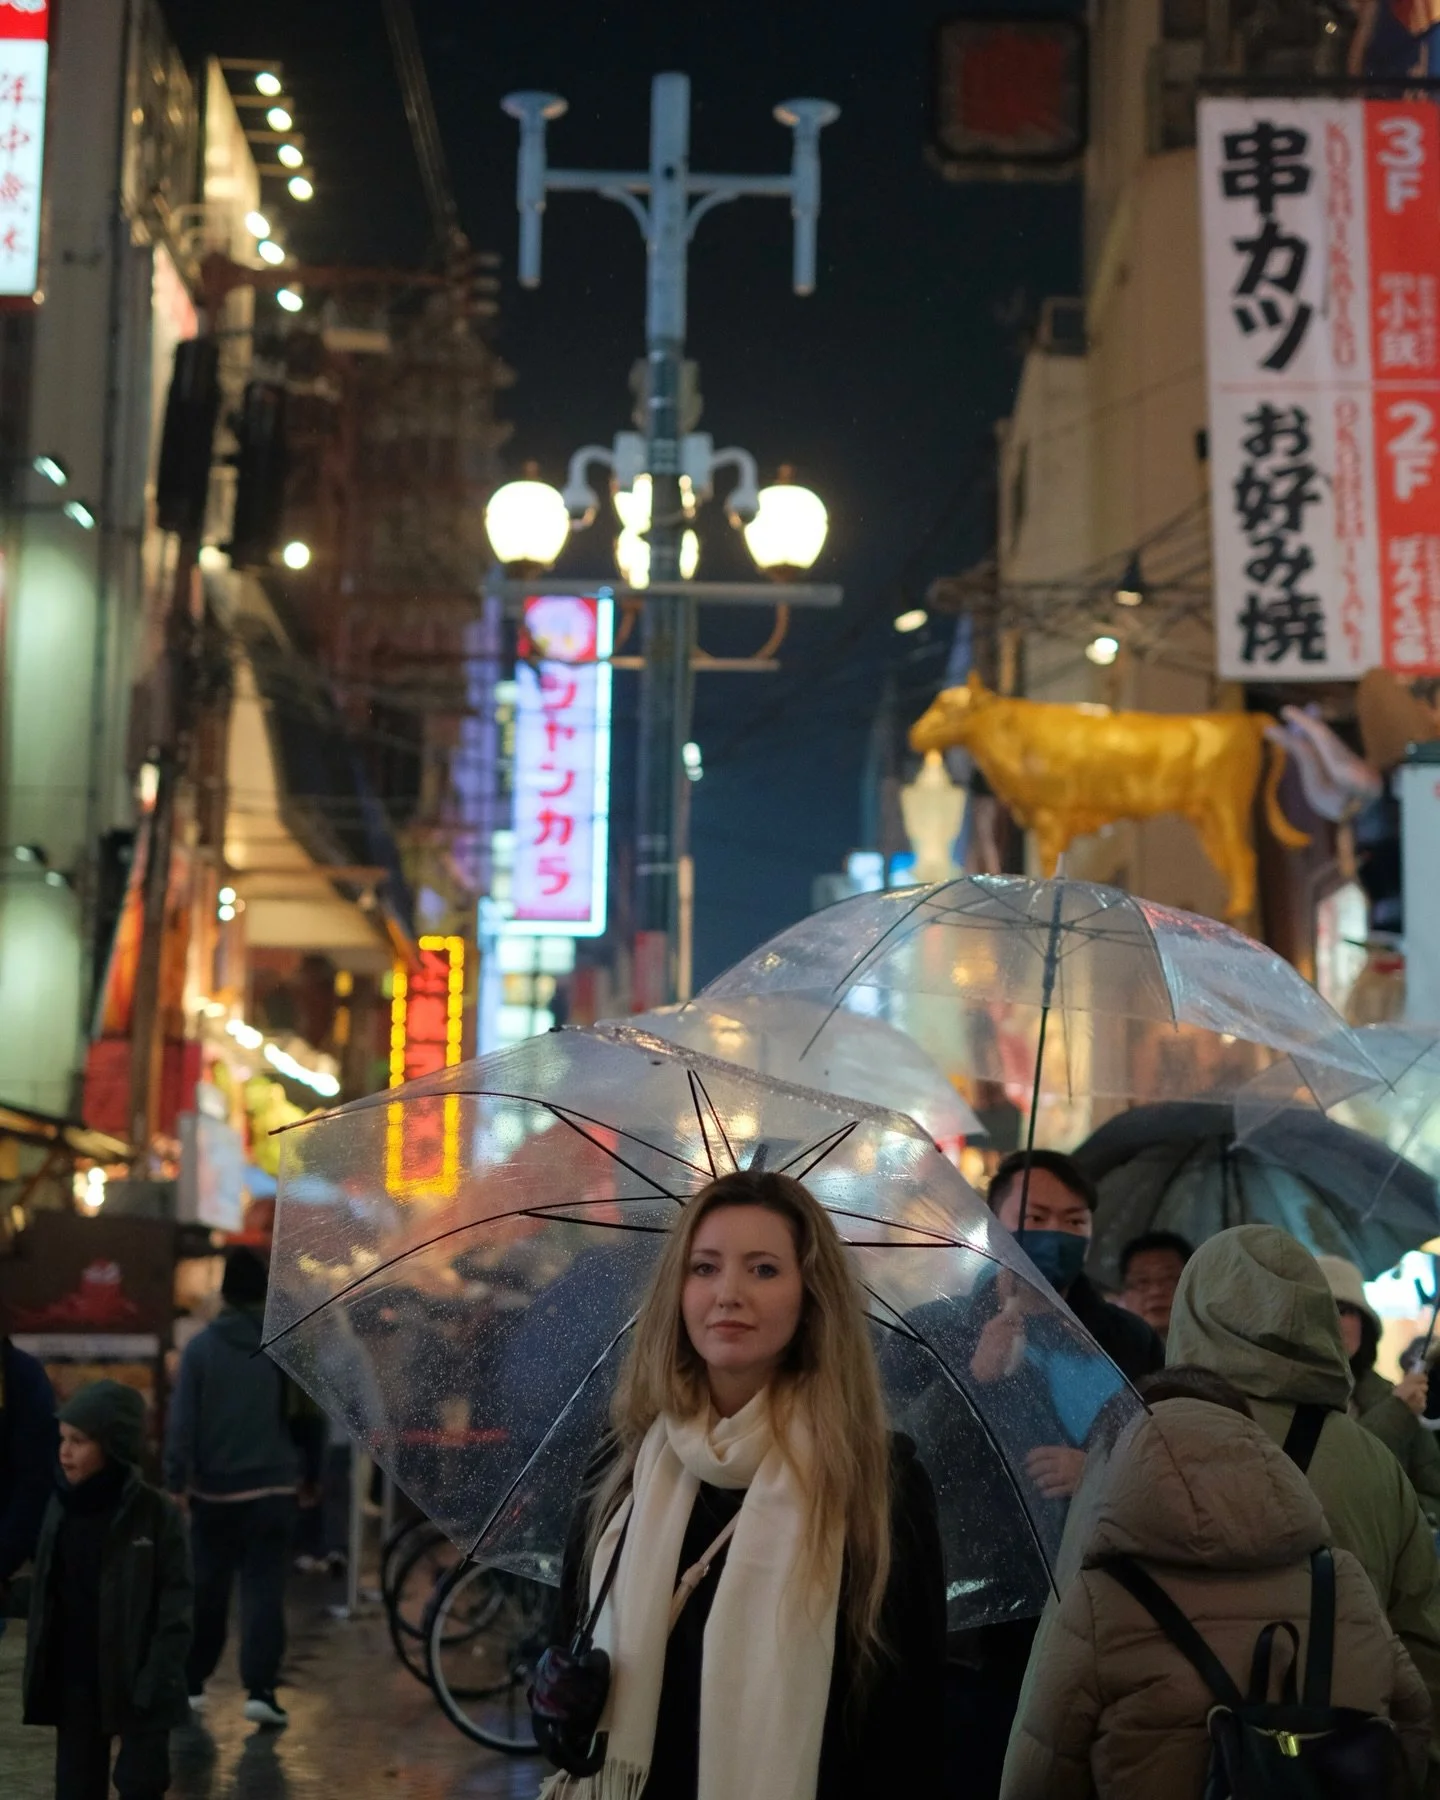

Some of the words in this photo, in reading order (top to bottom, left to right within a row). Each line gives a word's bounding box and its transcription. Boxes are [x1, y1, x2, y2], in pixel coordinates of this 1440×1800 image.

[1221, 118, 1313, 372] 串カツ
[1234, 402, 1328, 664] お好み焼
